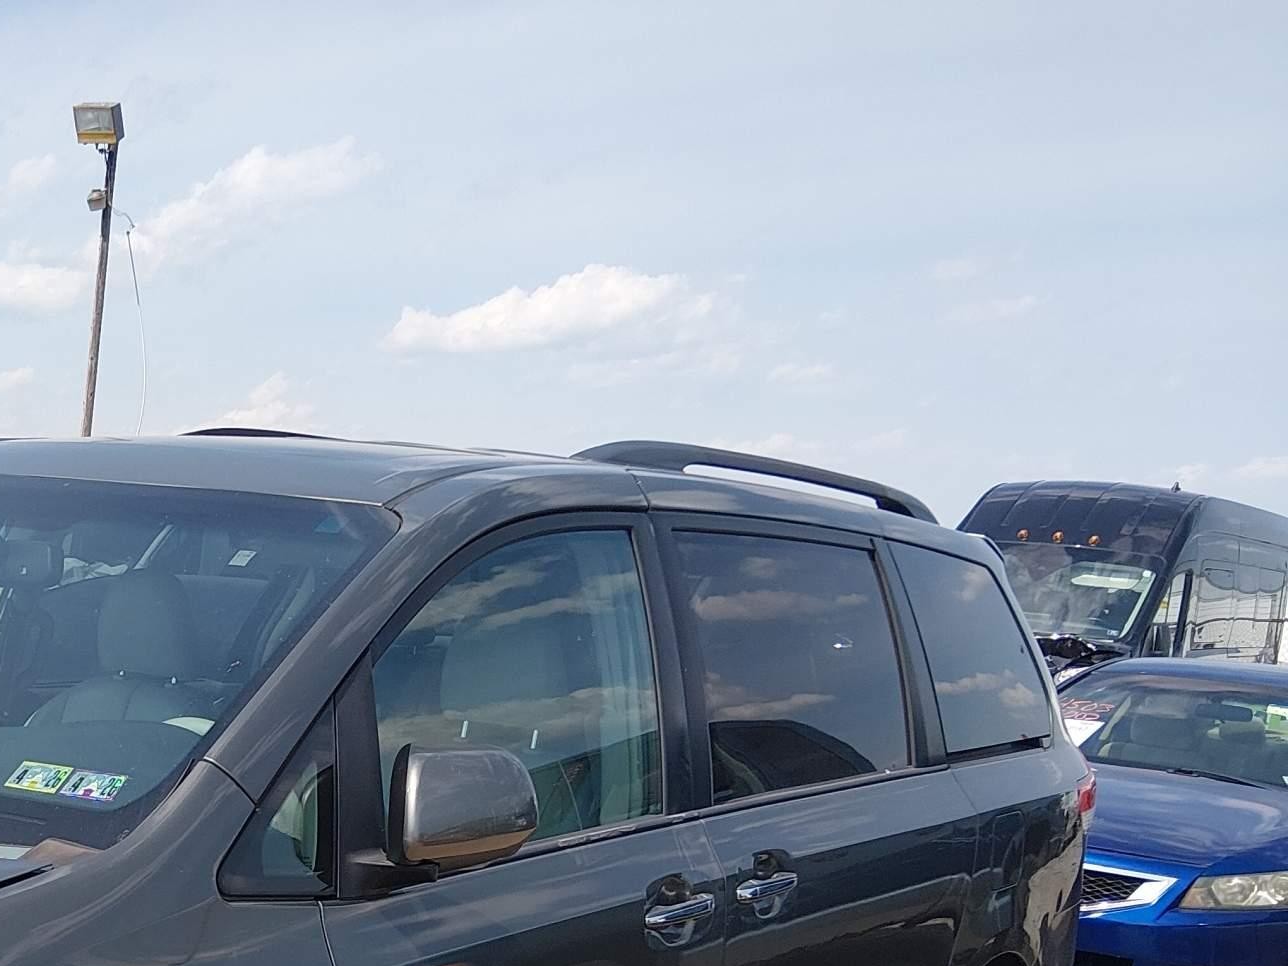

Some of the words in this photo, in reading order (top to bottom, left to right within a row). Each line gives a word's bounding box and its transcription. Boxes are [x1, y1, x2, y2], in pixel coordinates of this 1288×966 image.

[15, 769, 29, 785] 4
[45, 769, 68, 789] 26
[71, 776, 86, 793] 4
[100, 776, 123, 797] 26
